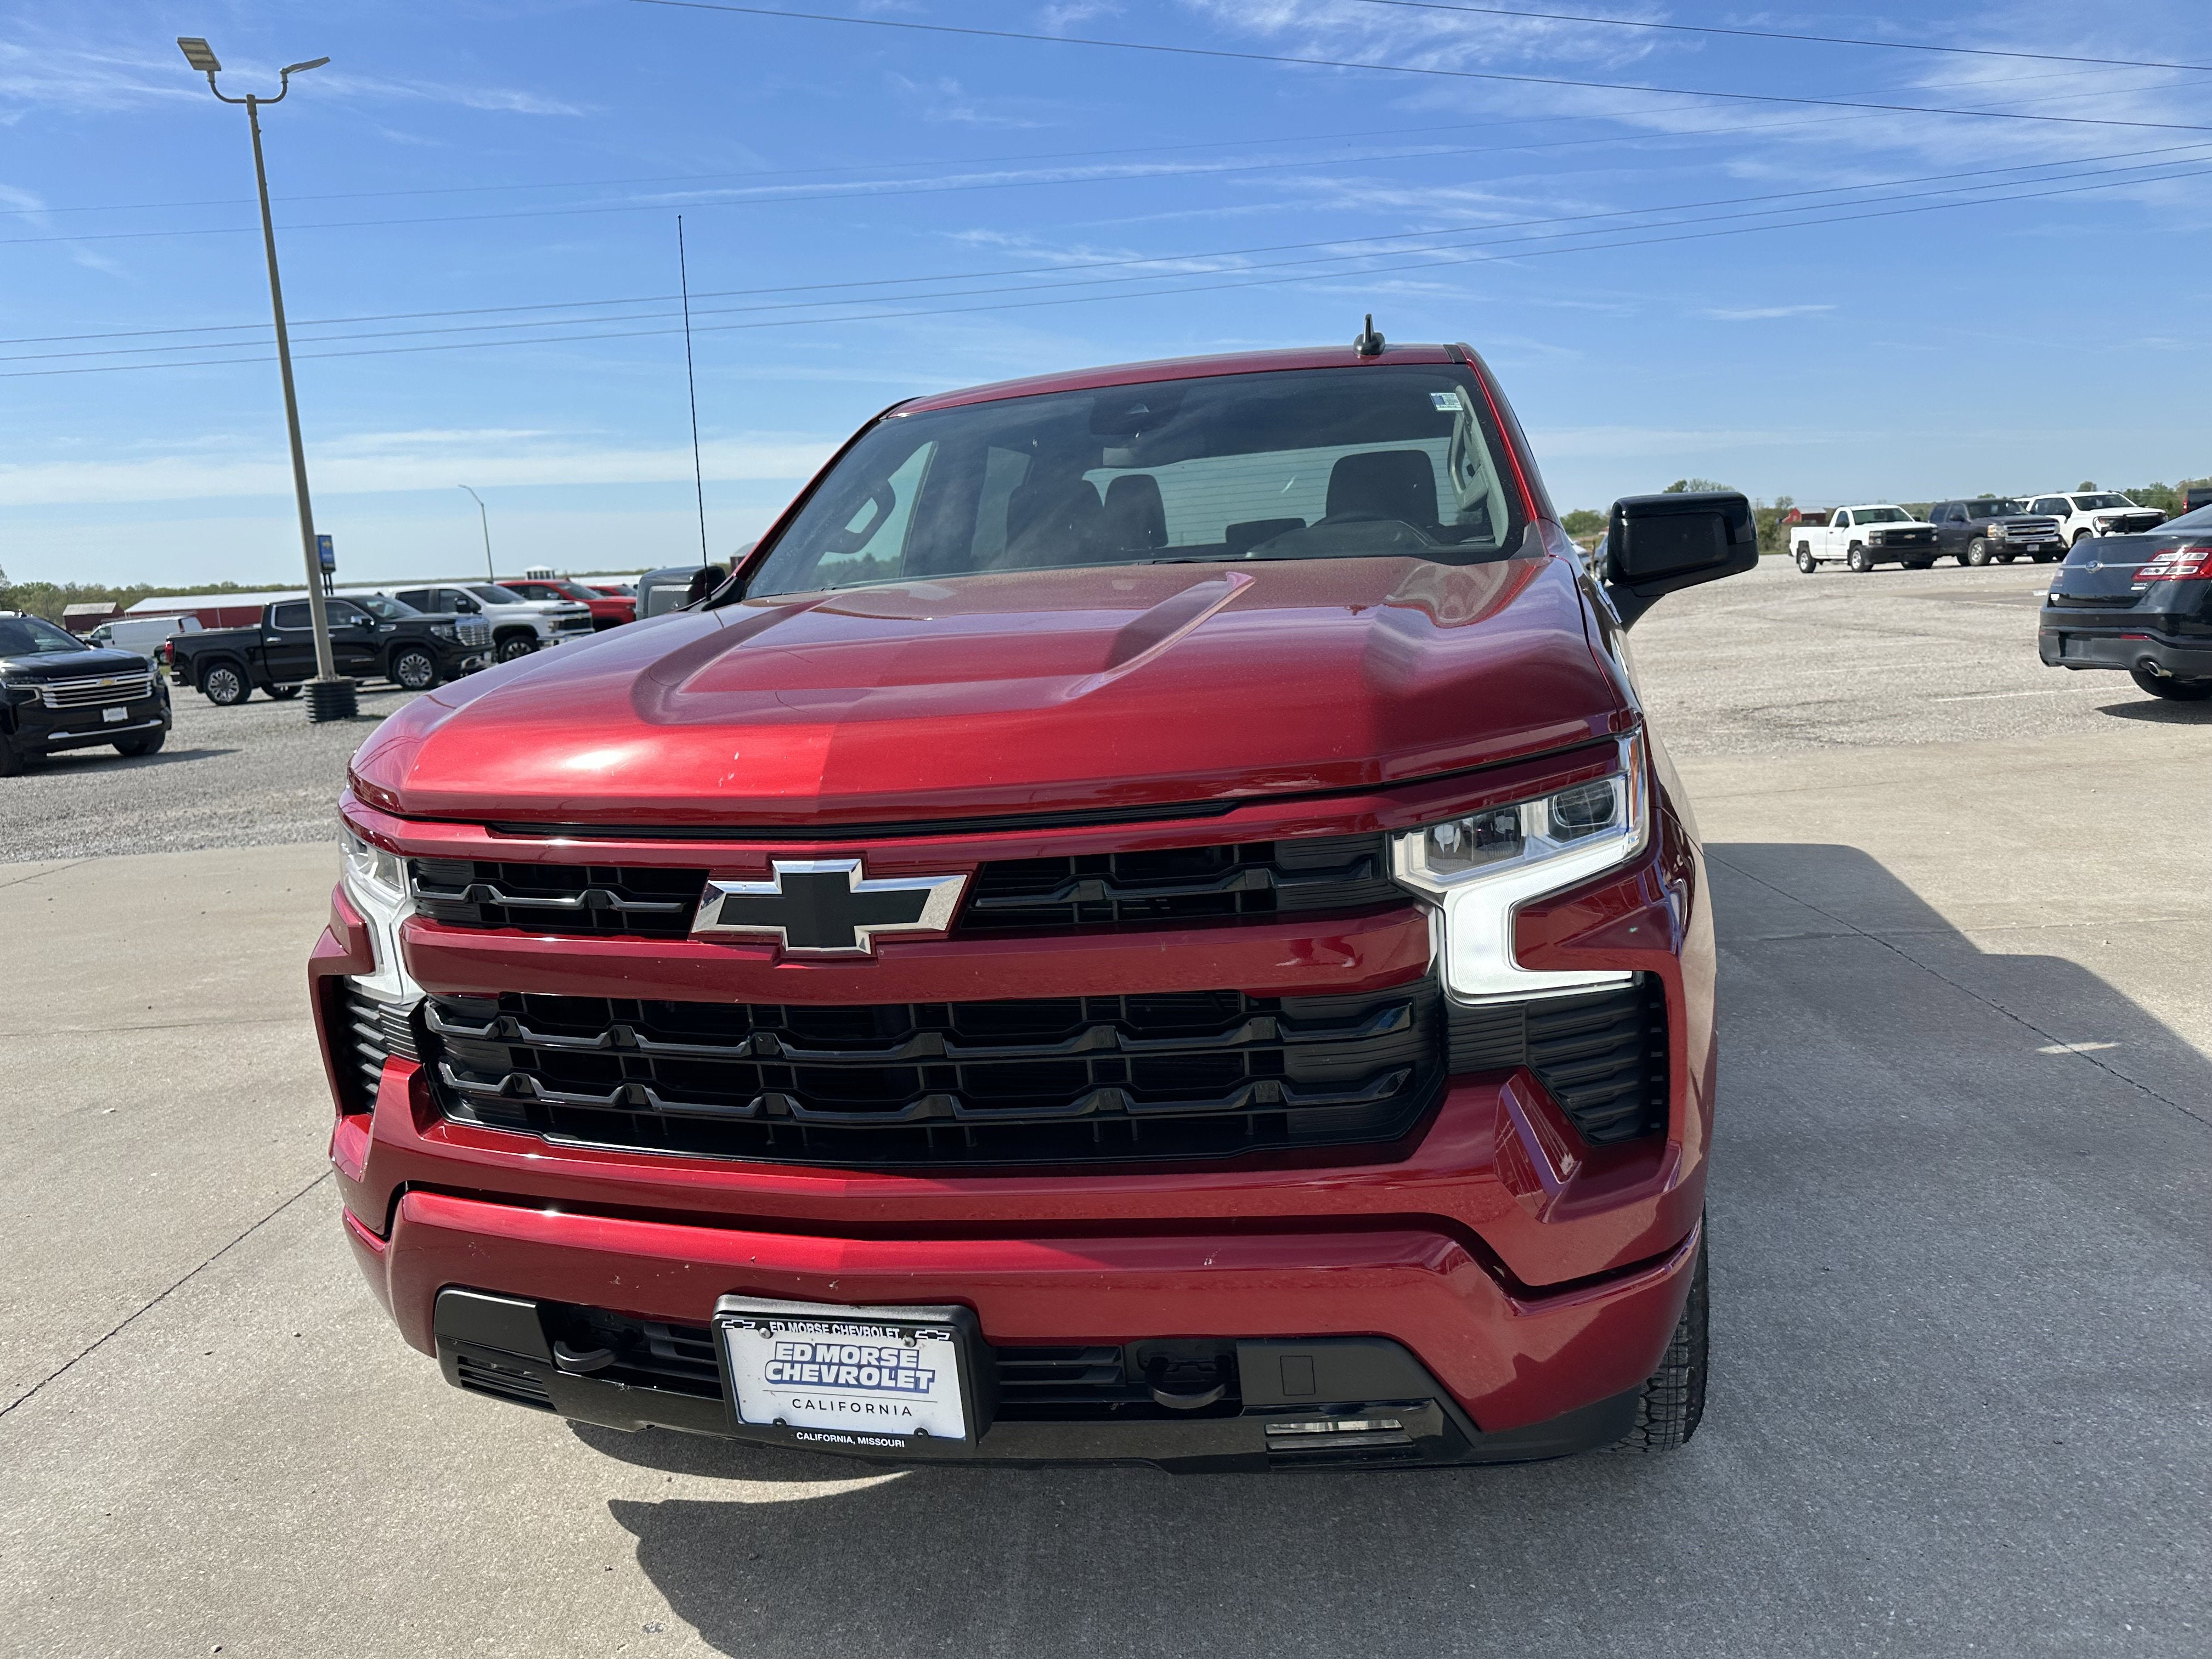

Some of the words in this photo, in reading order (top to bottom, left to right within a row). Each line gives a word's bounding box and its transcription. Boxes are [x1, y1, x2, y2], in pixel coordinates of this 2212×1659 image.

[769, 1321, 786, 1333] ED
[788, 1322, 830, 1335] MORSE
[832, 1324, 900, 1339] CHEVROLET
[775, 1341, 813, 1362] ED
[815, 1343, 918, 1368] MORSE
[765, 1360, 935, 1392] CHEVROLET
[792, 1398, 913, 1417] CALIFORNIA
[796, 1431, 856, 1445] CALIFORNIA,
[857, 1436, 905, 1448] MISSOURI
